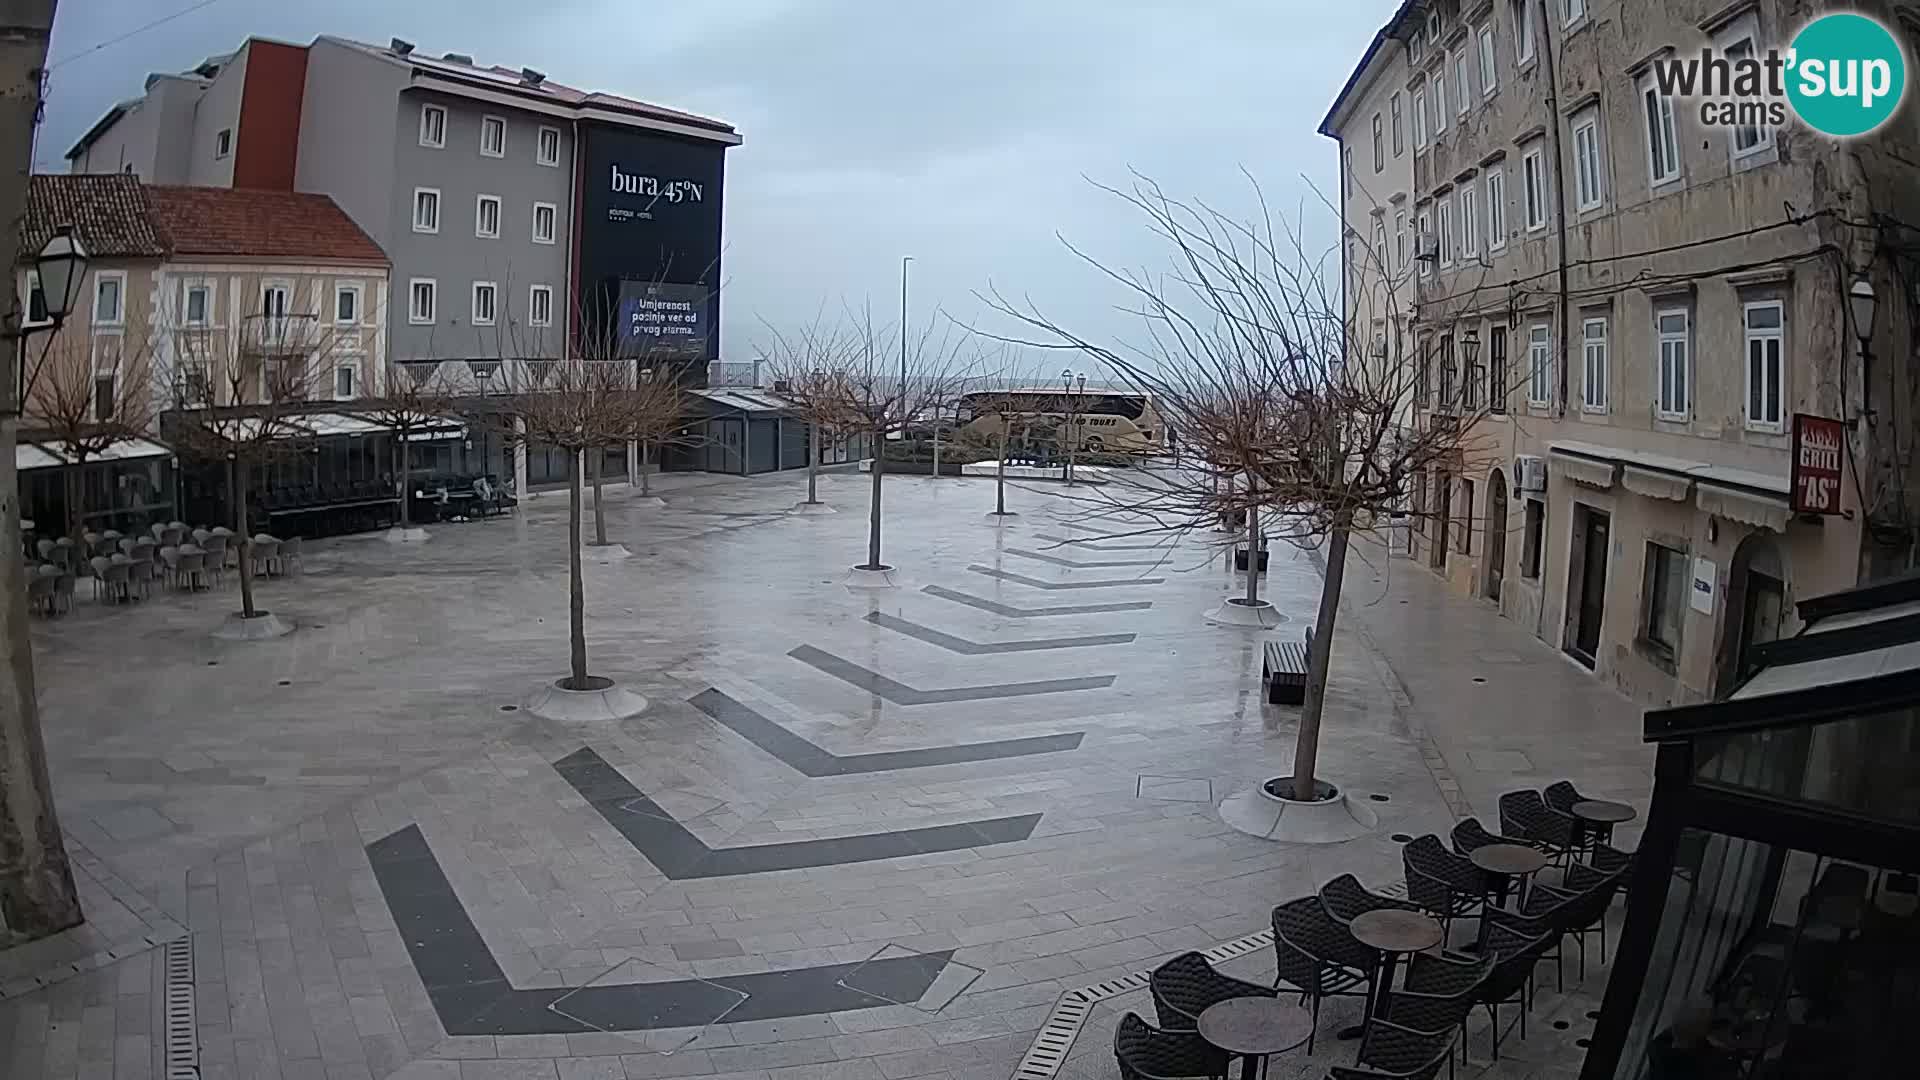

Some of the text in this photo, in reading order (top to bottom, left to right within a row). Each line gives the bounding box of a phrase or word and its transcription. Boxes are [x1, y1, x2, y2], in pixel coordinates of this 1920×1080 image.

[611, 165, 658, 196] bura
[684, 312, 697, 323] od
[1089, 418, 1117, 427] TOURS
[1800, 447, 1840, 472] GRILL
